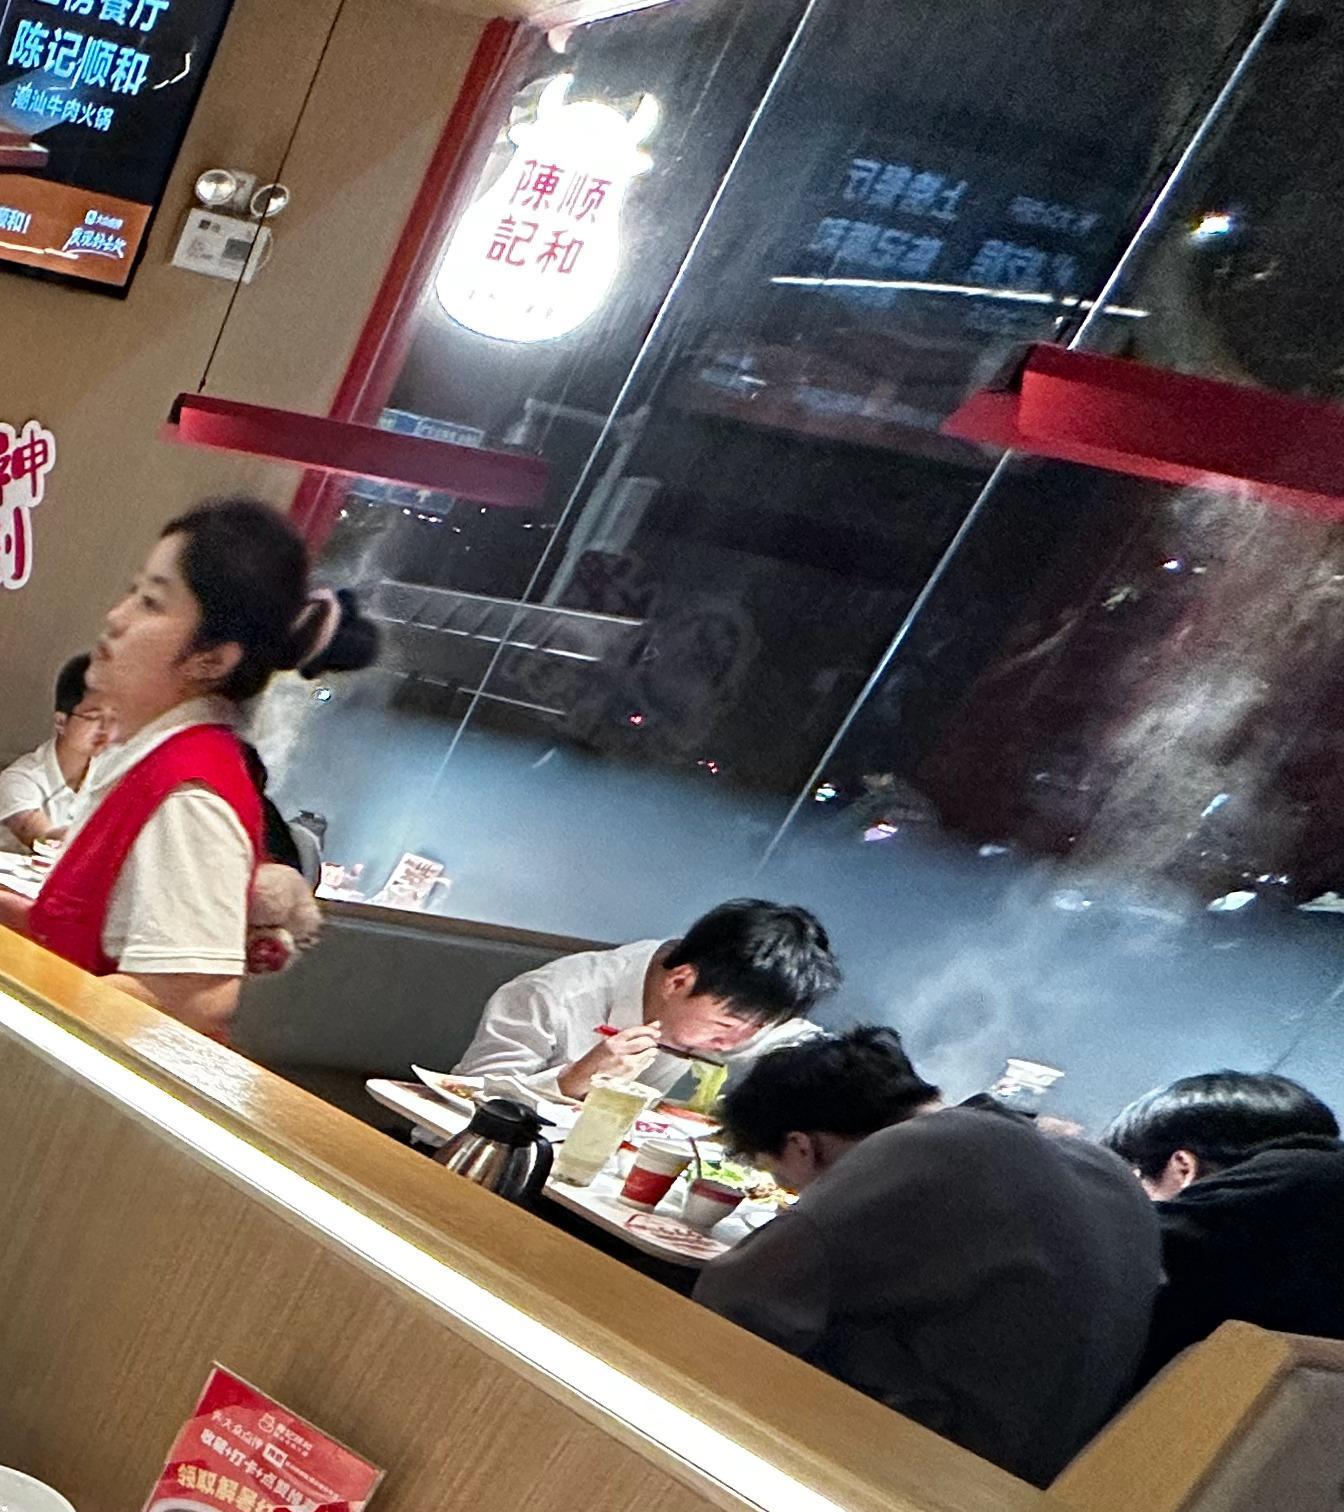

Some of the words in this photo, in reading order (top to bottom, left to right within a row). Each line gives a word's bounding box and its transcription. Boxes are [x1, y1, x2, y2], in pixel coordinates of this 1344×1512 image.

[9, 20, 152, 96] 陈记顺和
[11, 82, 115, 132] 潮汕牛肉火锅
